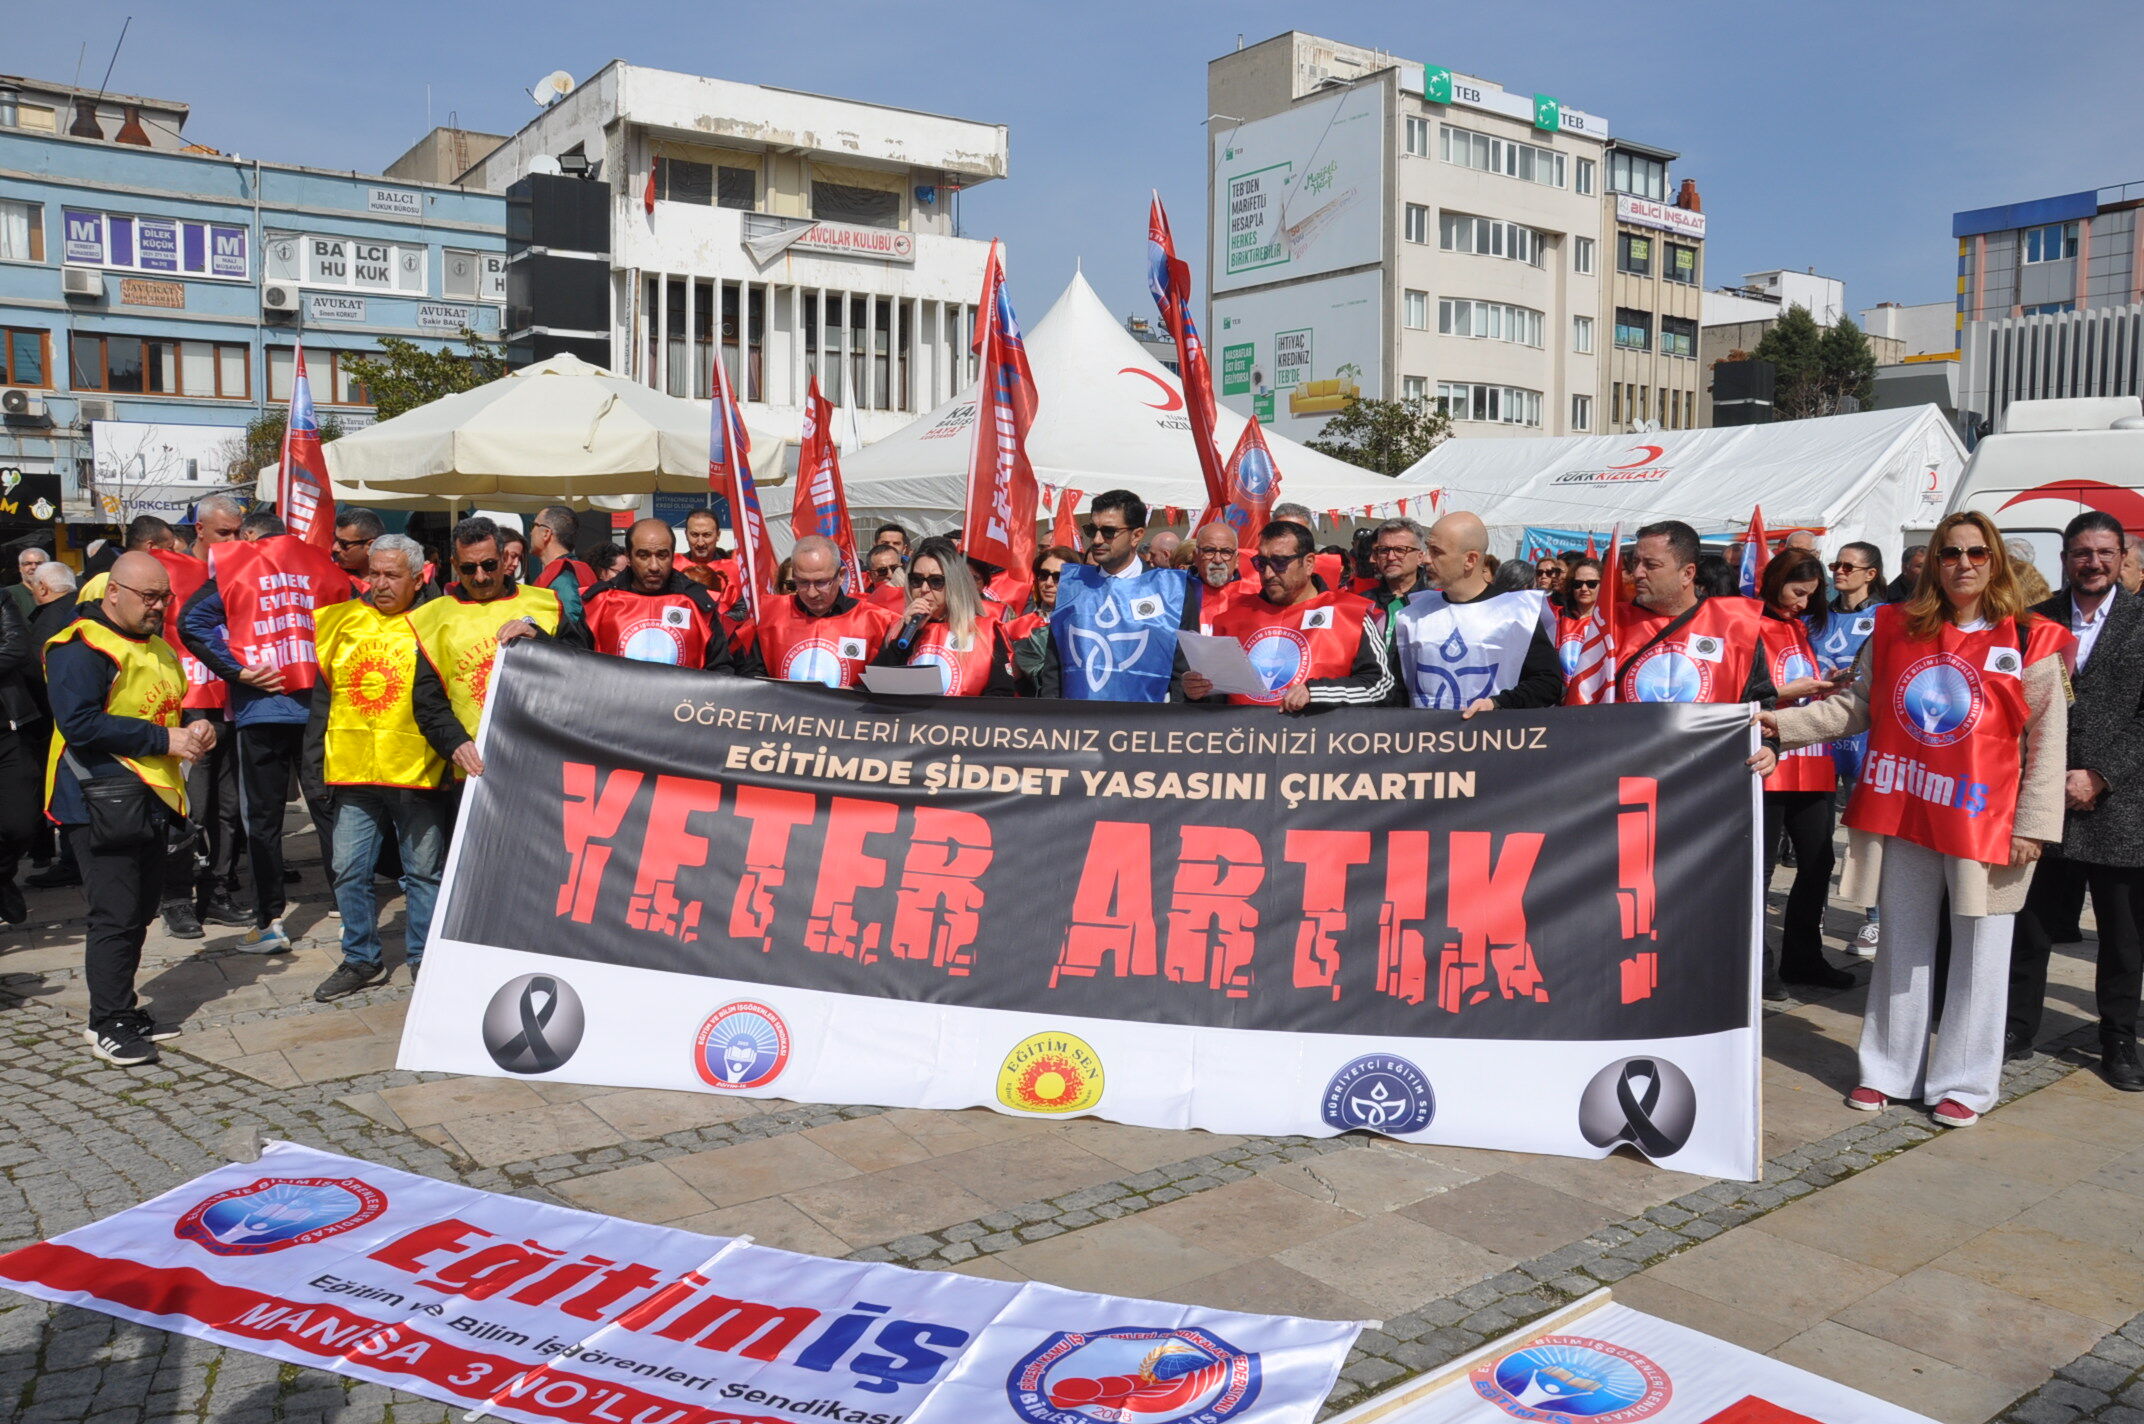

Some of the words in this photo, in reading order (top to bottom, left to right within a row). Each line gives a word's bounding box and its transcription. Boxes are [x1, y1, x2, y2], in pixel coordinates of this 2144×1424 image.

[1454, 84, 1481, 103] TEB
[1560, 112, 1584, 129] TEB
[376, 191, 414, 204] BALCI
[1232, 177, 1260, 198] TEB'DEN
[370, 202, 395, 211] HUKUK
[396, 203, 420, 214] BÜROSU
[1231, 194, 1267, 215] MARİFETLİ
[1630, 201, 1662, 219] BİLİCİ
[1664, 209, 1704, 229] İNŞAAT
[70, 220, 96, 242] M
[1231, 212, 1264, 233] HESAP'LA
[142, 239, 175, 250] KÜÇÜK
[144, 229, 171, 240] DİLEK
[810, 227, 850, 247] AVCILAR
[853, 230, 892, 251] KULÜBÜ
[1231, 231, 1257, 250] HERKES
[216, 236, 239, 256] M
[1231, 243, 1281, 267] BİRİKTİREBİLİR
[312, 298, 363, 310] AVUKAT
[419, 306, 467, 318] AVUKAT
[1278, 333, 1305, 351] İHTİYAÇ
[1277, 350, 1310, 367] KREDİNİZ
[1277, 368, 1300, 384] TEB'DE
[258, 572, 311, 591] EMEK
[259, 591, 315, 612] EYLEM
[673, 698, 900, 744] ÖĞRETMENLERİ
[908, 722, 1100, 752] KORURSANIZ
[1109, 725, 1317, 755] GELECEĞİNİZİ
[1327, 726, 1548, 755] KORURSUNUZ
[725, 741, 913, 786] EĞİTİMDE
[923, 754, 1069, 795] ŞİDDET
[1080, 769, 1266, 801] YASASINI
[1280, 770, 1476, 809] ÇIKARTIN
[555, 761, 995, 977] YETER
[1048, 820, 1550, 1014] ARTIK
[1616, 775, 1660, 1005] !
[719, 1005, 737, 1018] BİLİM
[1006, 1038, 1068, 1074] EĞİTİM
[1071, 1048, 1099, 1080] SEN
[1327, 1059, 1380, 1118] HÜRRİYETÇİ
[1386, 1061, 1425, 1095] EĞİTİM
[1415, 1100, 1429, 1123] SEN
[307, 1273, 405, 1309] Eğitim
[408, 1301, 446, 1318] ve
[446, 1315, 532, 1348] Bilim
[531, 1335, 718, 1392] İşgörenleri
[229, 1302, 433, 1366] MANİSA
[447, 1362, 494, 1387] 3
[1041, 1339, 1070, 1364] KAMU
[1534, 1336, 1584, 1346] BİLİM
[1586, 1339, 1667, 1392] İŞGÖRENLERİ
[1090, 1405, 1133, 1423] 2008
